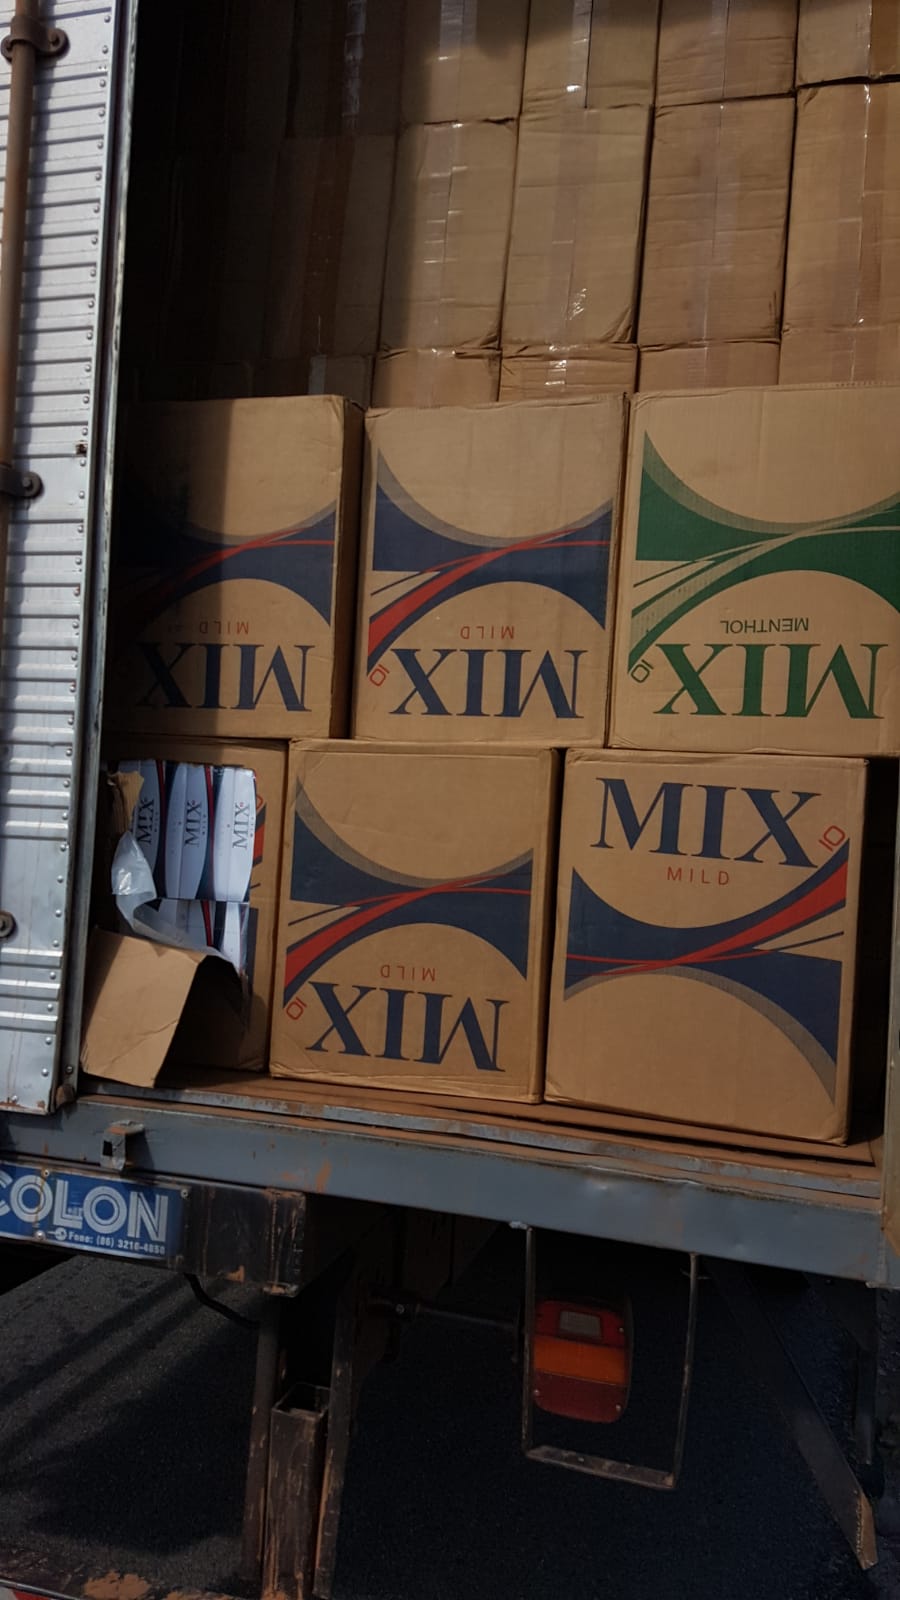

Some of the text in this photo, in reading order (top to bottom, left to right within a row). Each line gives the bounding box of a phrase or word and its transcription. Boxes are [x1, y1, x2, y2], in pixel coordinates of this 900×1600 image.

[199, 621, 249, 635] MILD
[460, 625, 514, 640] MILD
[720, 617, 809, 634] MENTHOL
[136, 642, 315, 712] MIX
[388, 648, 588, 719] MIX
[653, 643, 888, 719] MIX
[138, 798, 155, 845] MIX
[184, 801, 202, 847] MIX
[232, 803, 250, 850] MIX
[590, 777, 821, 868] MIX
[667, 866, 730, 885] MILD
[380, 964, 436, 982] MILD
[305, 981, 510, 1072] MIX
